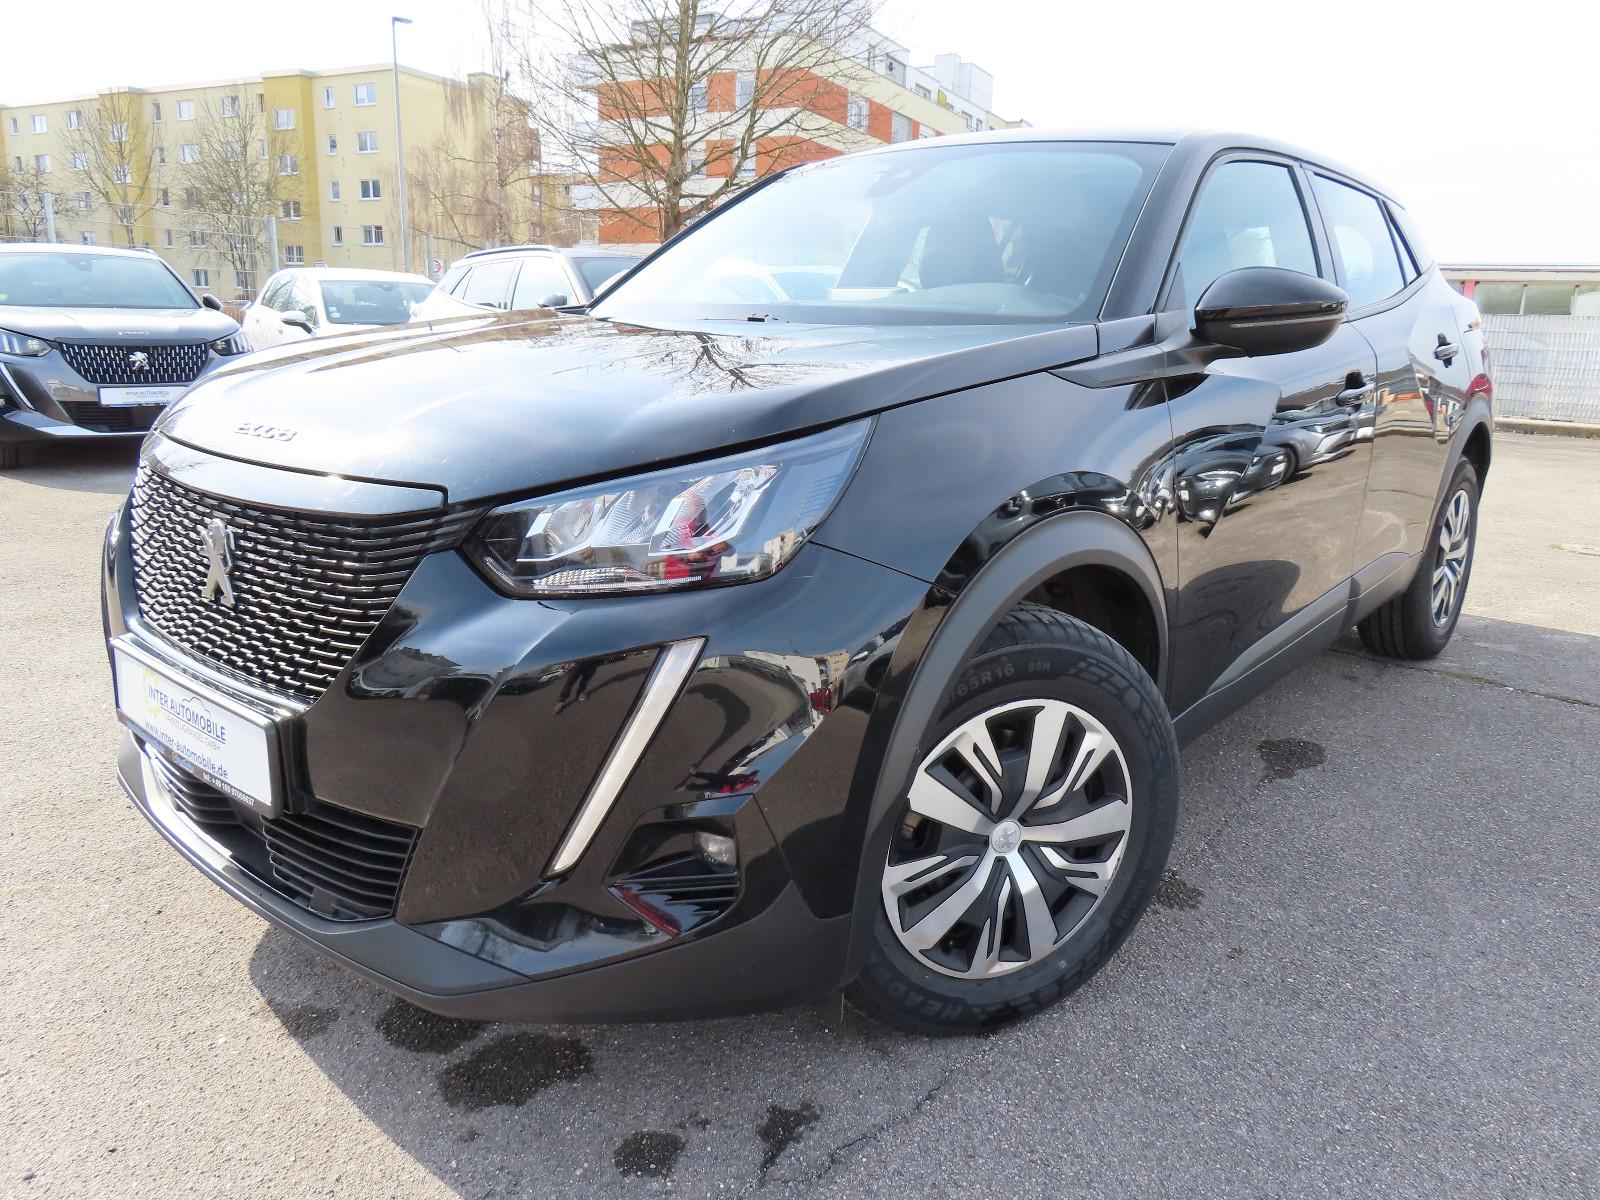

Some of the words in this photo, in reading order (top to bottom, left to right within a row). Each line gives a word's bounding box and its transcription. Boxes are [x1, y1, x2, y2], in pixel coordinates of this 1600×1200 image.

[147, 683, 169, 709] INTER
[170, 697, 227, 742] AUTOMOBILE
[145, 720, 229, 779] www.inter-automobile.de
